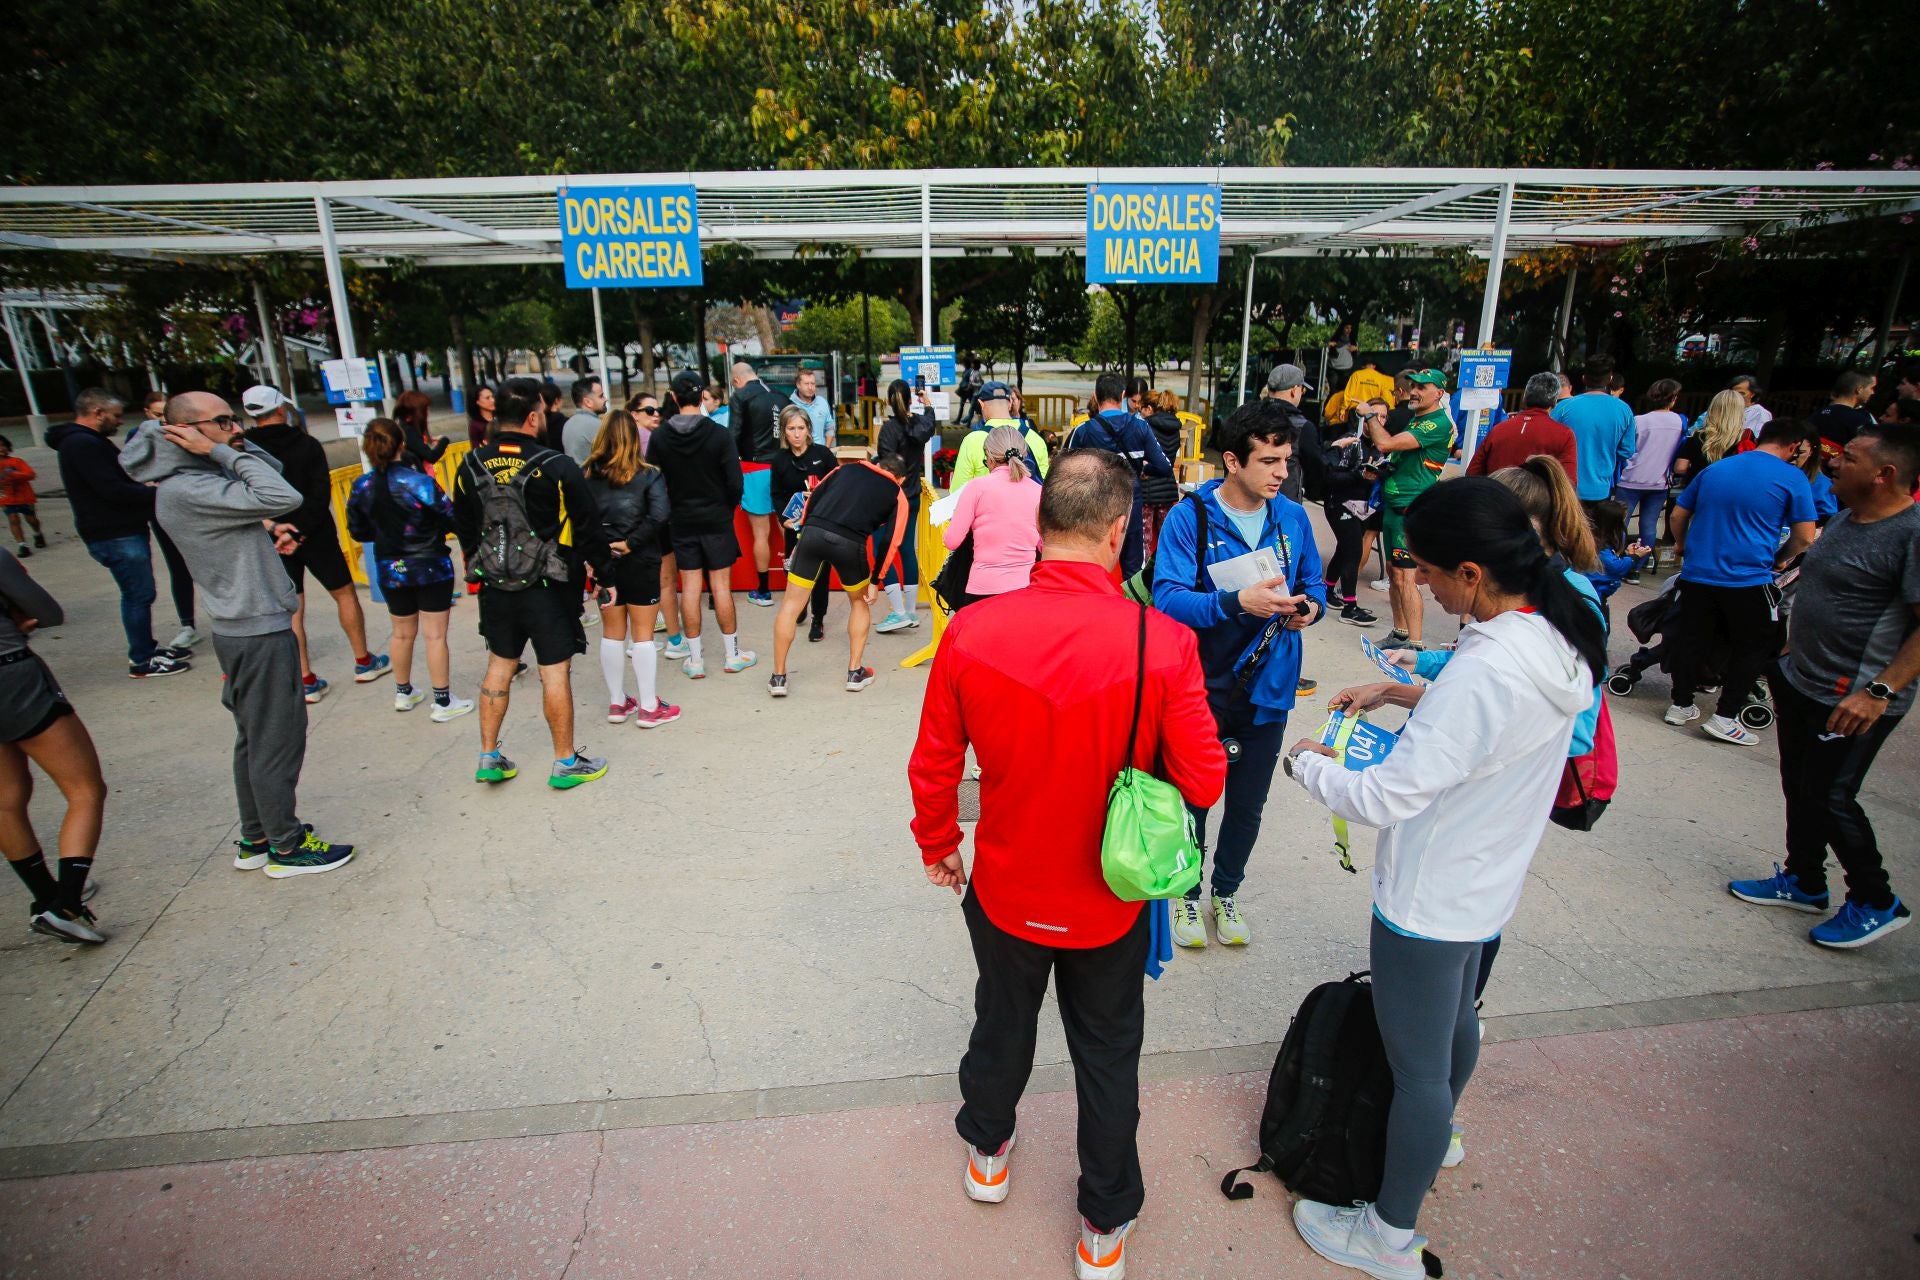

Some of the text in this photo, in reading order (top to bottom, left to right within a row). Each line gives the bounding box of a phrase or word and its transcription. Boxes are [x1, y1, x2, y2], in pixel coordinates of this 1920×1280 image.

[564, 195, 693, 236] DORSALES
[1093, 193, 1215, 232] DORSALES
[576, 240, 691, 280] CARRERA
[1104, 237, 1202, 275] MARCHA
[1346, 723, 1379, 761] 047
